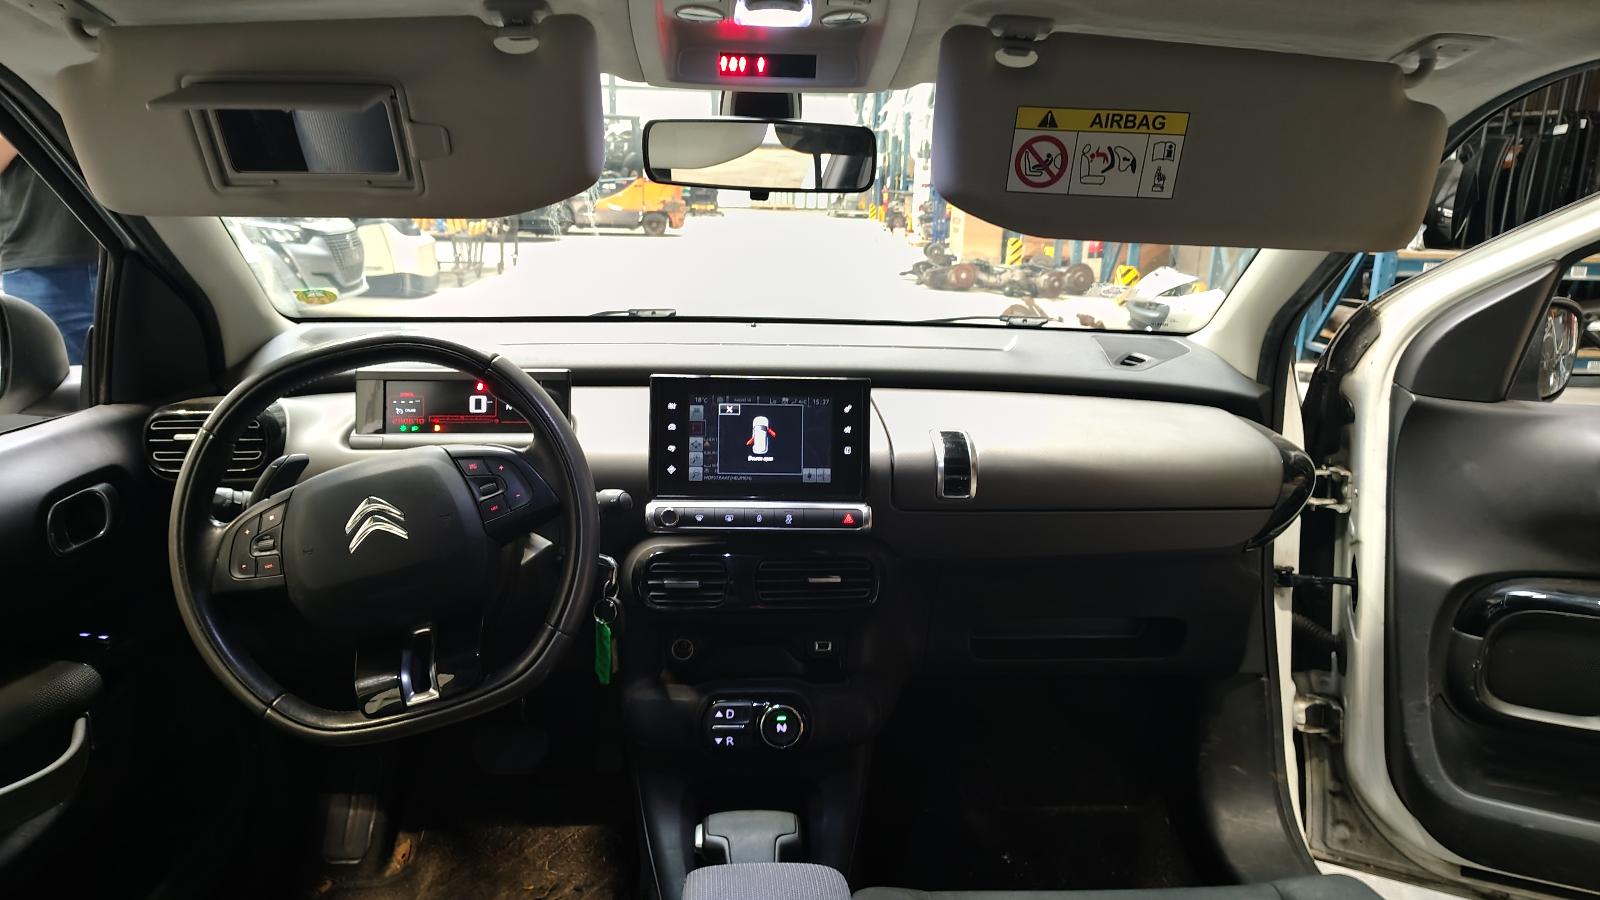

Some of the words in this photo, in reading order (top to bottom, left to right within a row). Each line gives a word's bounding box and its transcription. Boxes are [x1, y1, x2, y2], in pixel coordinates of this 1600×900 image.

[1090, 113, 1166, 130] AIRBAG
[469, 395, 487, 413] 0
[726, 709, 735, 719] D
[776, 723, 787, 733] N
[726, 737, 735, 746] R
